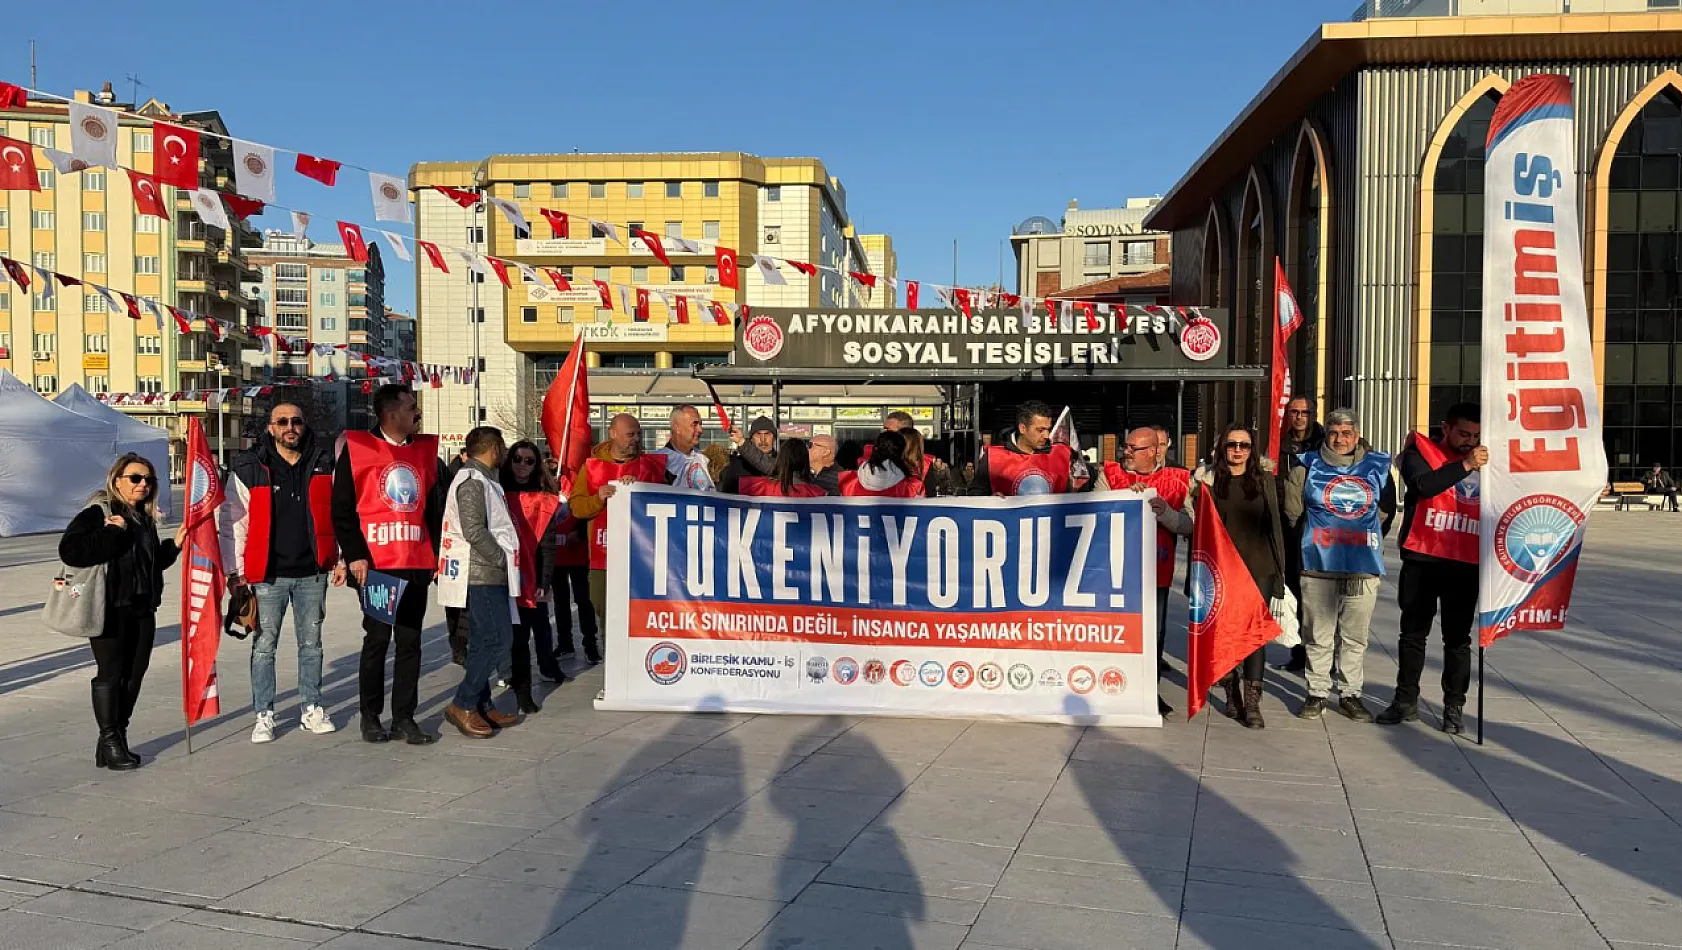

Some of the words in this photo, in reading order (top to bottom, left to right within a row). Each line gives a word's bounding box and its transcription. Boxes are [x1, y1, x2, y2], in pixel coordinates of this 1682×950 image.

[1076, 223, 1134, 236] SOYDAN
[582, 326, 619, 337] TKDK
[788, 312, 1019, 335] AFYONKARAHİSAR
[843, 341, 958, 364] SOSYAL
[966, 337, 1120, 365] TESİSLERİ
[441, 433, 467, 441] KAR
[367, 520, 421, 546] Eğitim
[645, 503, 1126, 609] TÜKENİYORUZ!
[646, 611, 697, 633] AÇLIK
[701, 614, 789, 634] SINIRINDA
[793, 613, 848, 638] DEĞİL,
[852, 614, 930, 640] İNSANCA
[934, 622, 1023, 643] YAŞAMAK
[1027, 618, 1125, 645] İSTİYORUZ
[690, 654, 740, 666] BİRLEŞİK
[742, 657, 775, 667] KAMU
[785, 657, 795, 668] İŞ
[690, 667, 781, 679] KONFEDERASYONU
